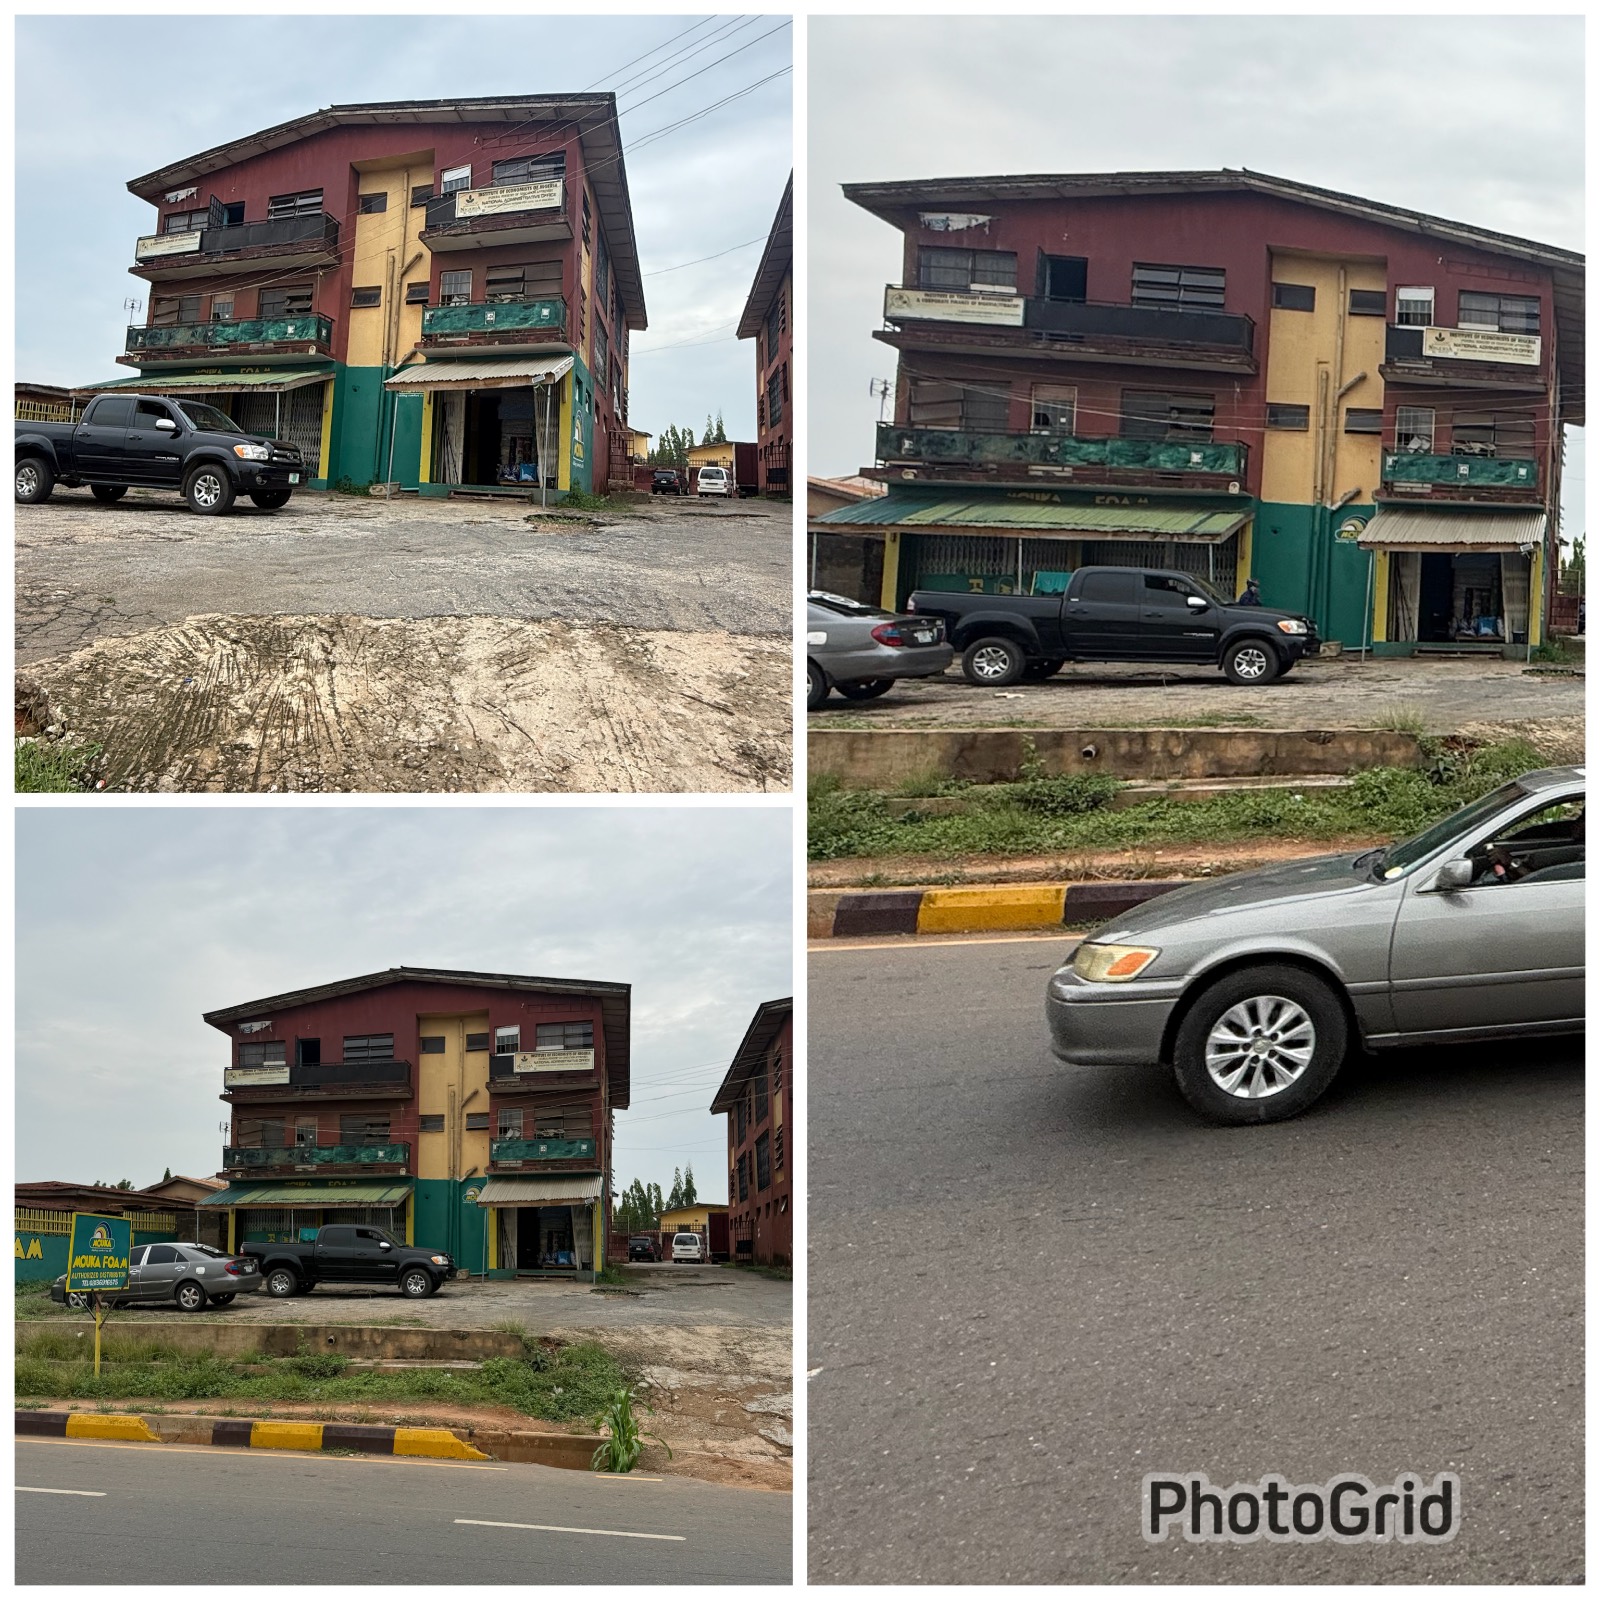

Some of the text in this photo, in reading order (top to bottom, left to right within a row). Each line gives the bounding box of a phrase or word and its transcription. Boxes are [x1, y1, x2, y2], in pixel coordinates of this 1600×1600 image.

[93, 1240, 112, 1248] MOUKA
[73, 1254, 128, 1268] MOUKA FOAM
